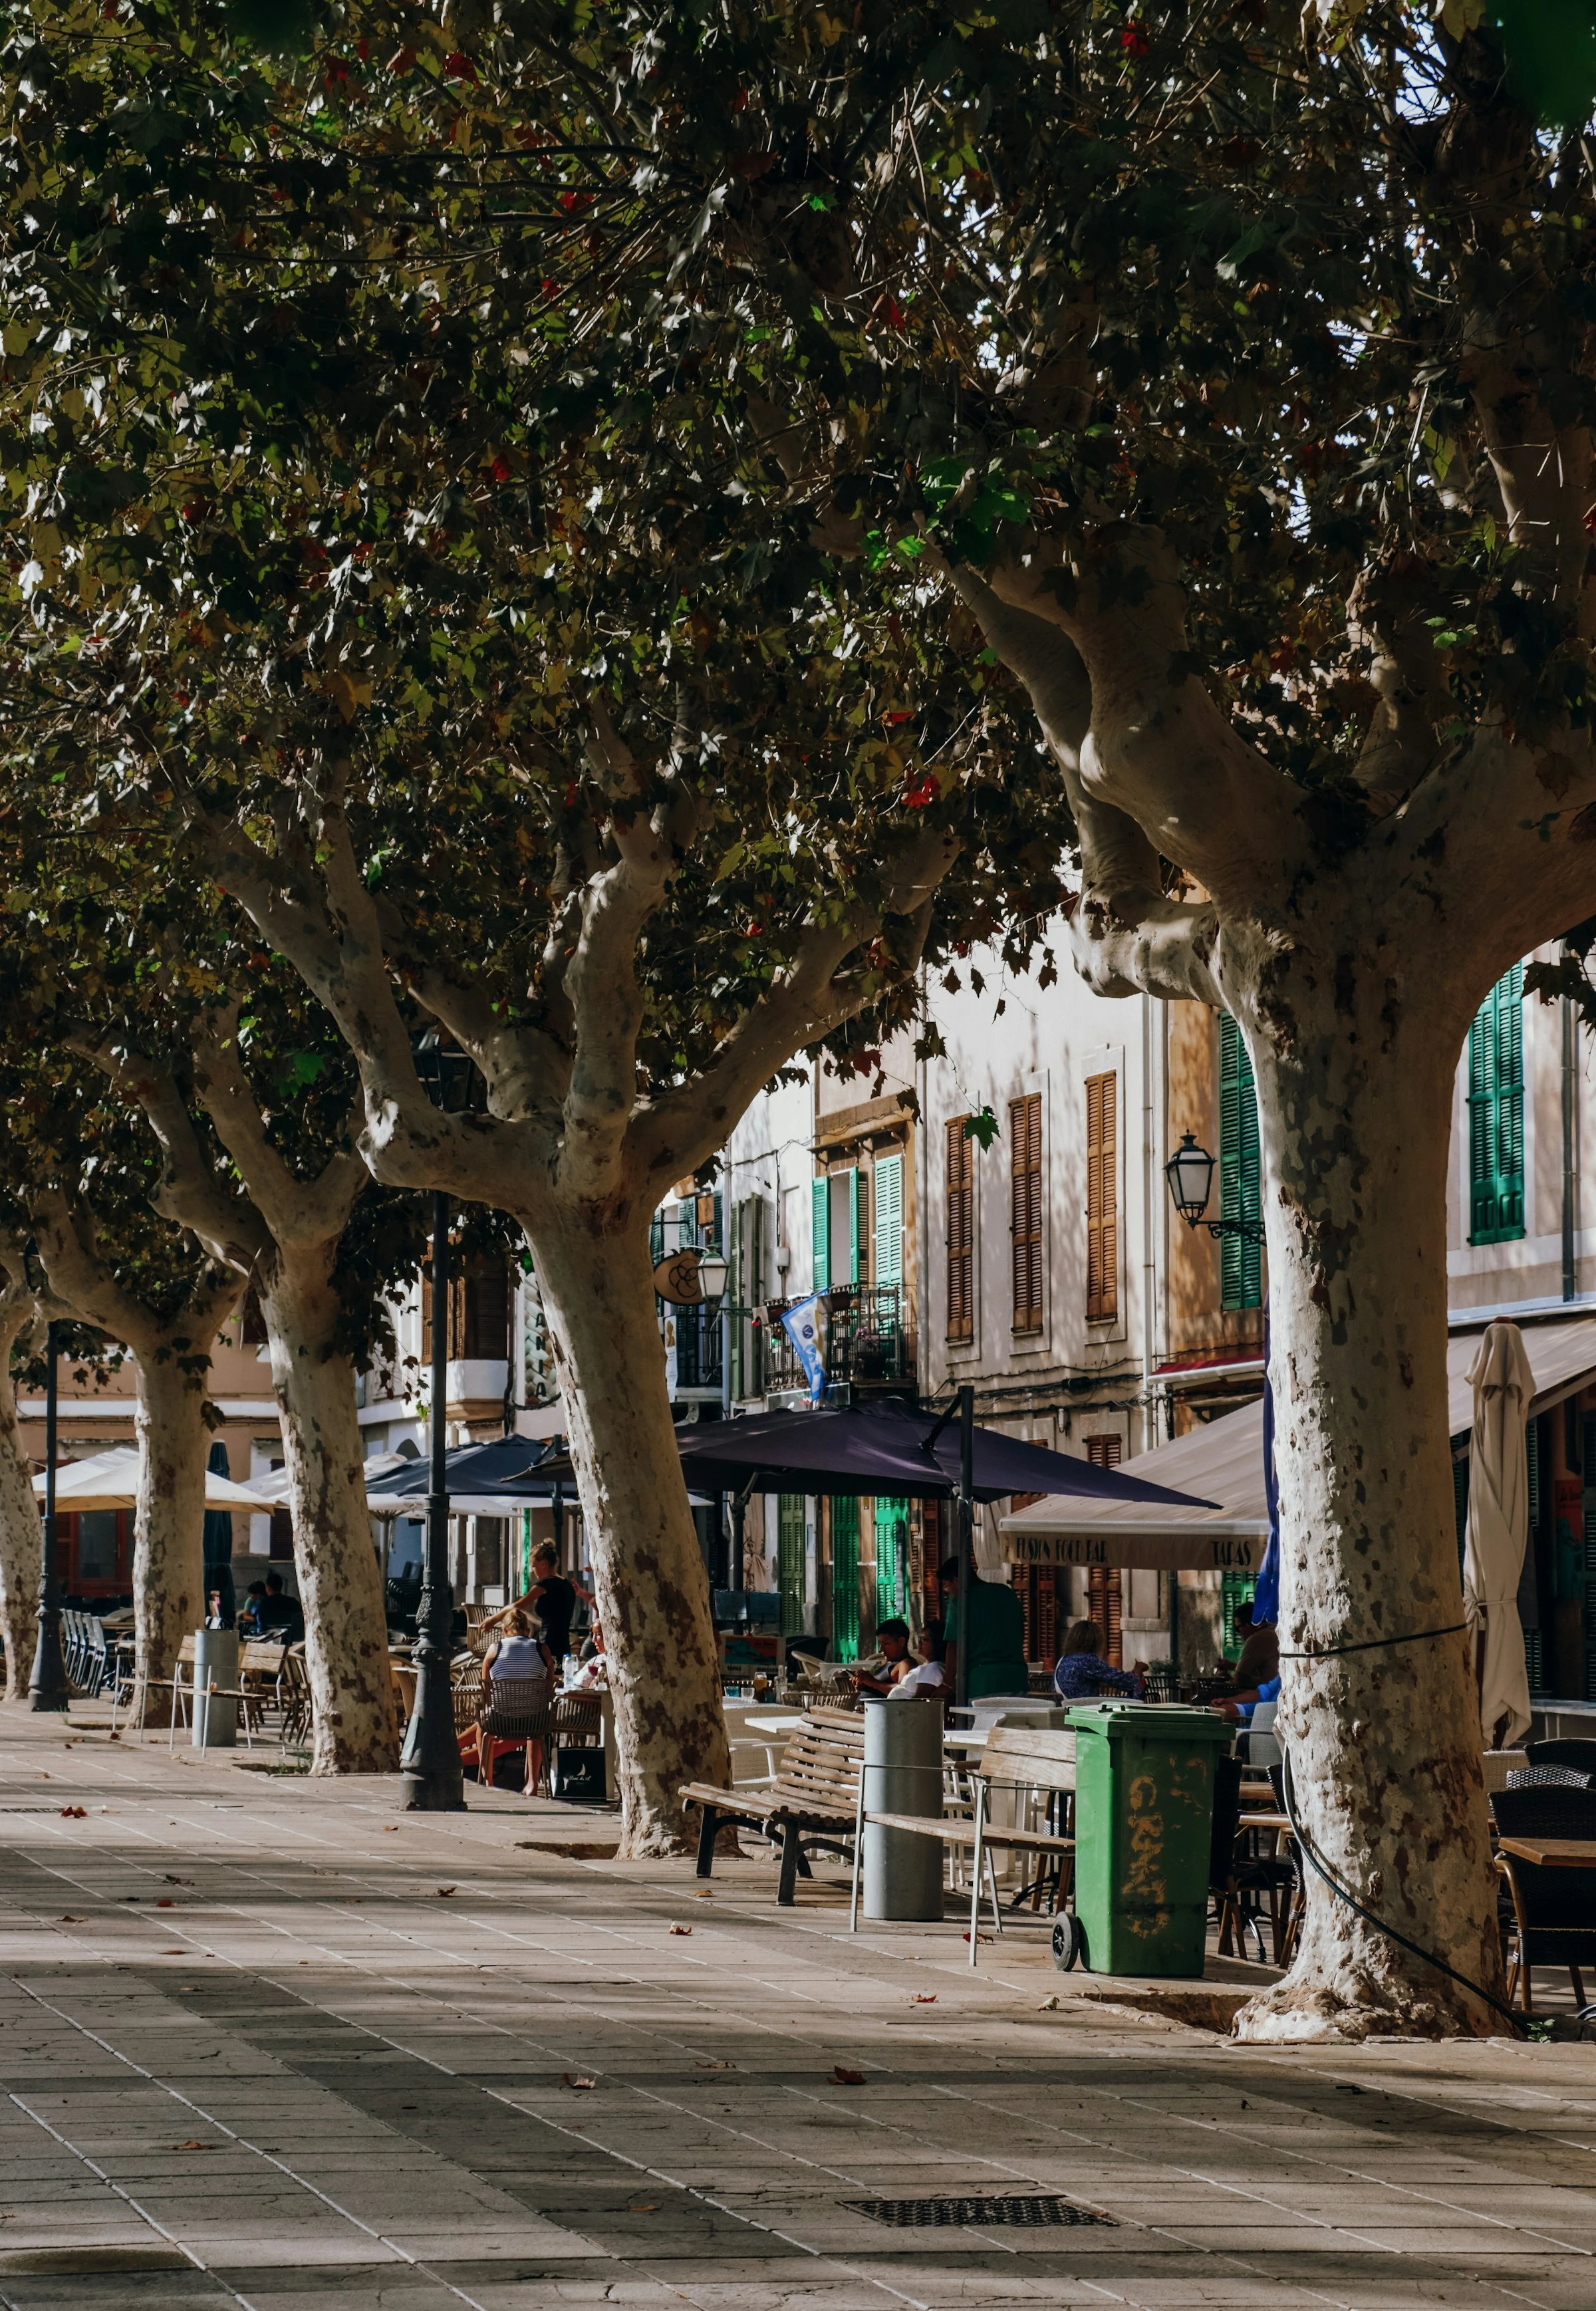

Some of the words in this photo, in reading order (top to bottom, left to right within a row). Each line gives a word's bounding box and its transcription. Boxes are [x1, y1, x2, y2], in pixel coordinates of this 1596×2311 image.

[1017, 1538, 1051, 1560] FUSION
[1055, 1539, 1081, 1562] FOOD
[1087, 1540, 1109, 1562] BAR
[1212, 1542, 1252, 1566] TAPAS
